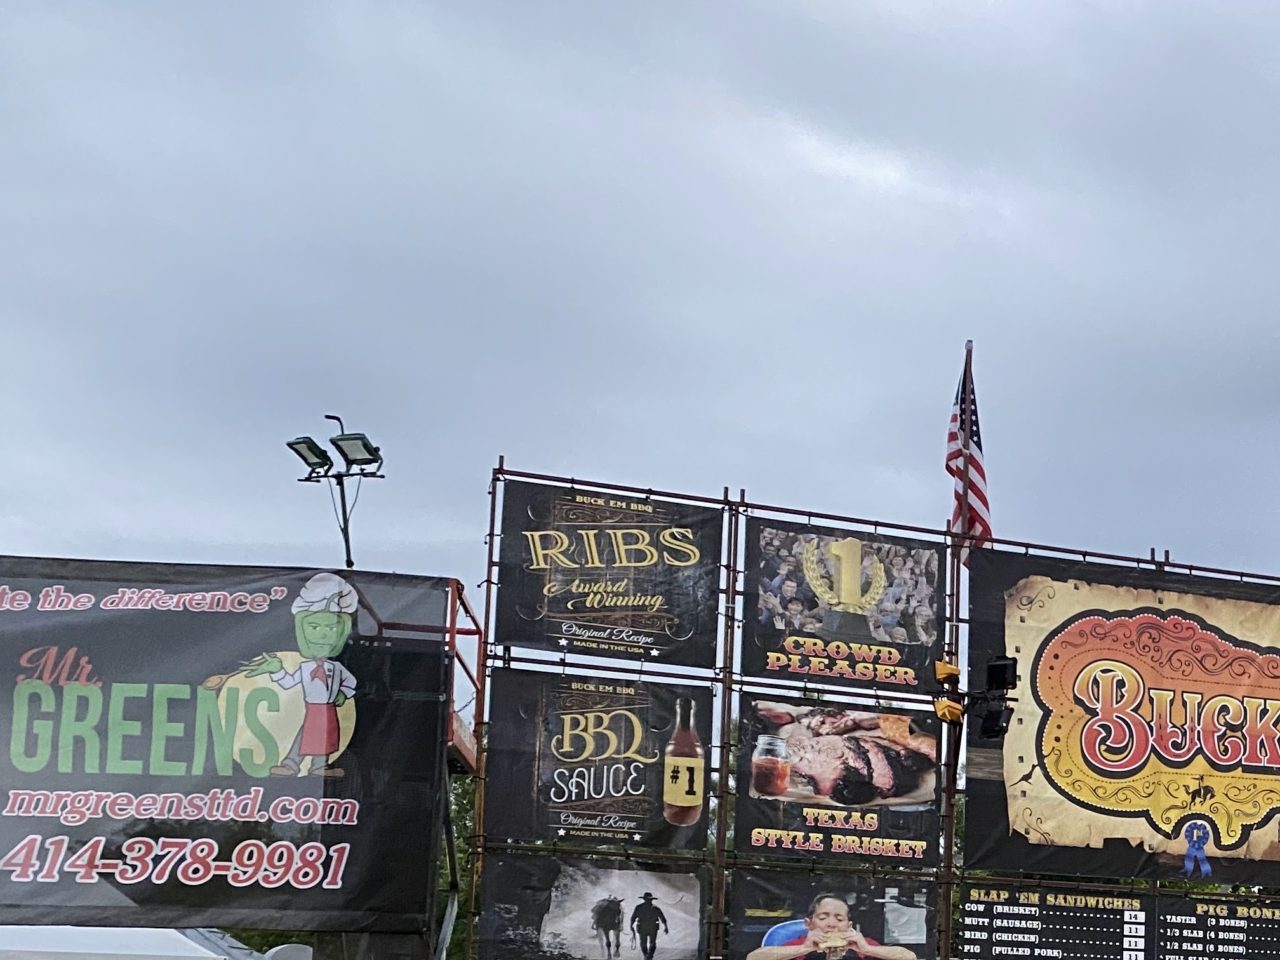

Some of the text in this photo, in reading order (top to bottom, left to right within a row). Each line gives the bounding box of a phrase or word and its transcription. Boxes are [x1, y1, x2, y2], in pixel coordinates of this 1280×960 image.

[575, 494, 653, 513] BUCK EM BBQ
[522, 528, 701, 570] RIBS
[37, 586, 94, 611] the
[543, 578, 628, 597] Award
[567, 592, 664, 610] Winning
[561, 622, 655, 645] Original Recipe
[573, 640, 645, 654] MADE IN THE USA
[784, 635, 901, 665] CROWD
[17, 646, 103, 688] Mr.
[767, 651, 918, 686] PLEASER
[9, 679, 280, 778] GREENS
[551, 710, 660, 763] BBQ
[550, 762, 646, 803] SAUCE
[669, 764, 697, 797] #1
[3, 787, 359, 826] mrgreensttd.com
[803, 807, 878, 831] TEXAS
[751, 828, 927, 859] STYLE BRISKET
[0, 835, 350, 889] 414-378-9981
[965, 903, 1039, 916] COW (BRISKET)
[970, 889, 1141, 910] SLAP 'EM SANDWICHES
[1196, 903, 1229, 916] PIG
[964, 917, 1041, 930] MUTT (SAUSAGE)
[1166, 915, 1197, 924] TASTER
[1219, 919, 1247, 928] BONES)
